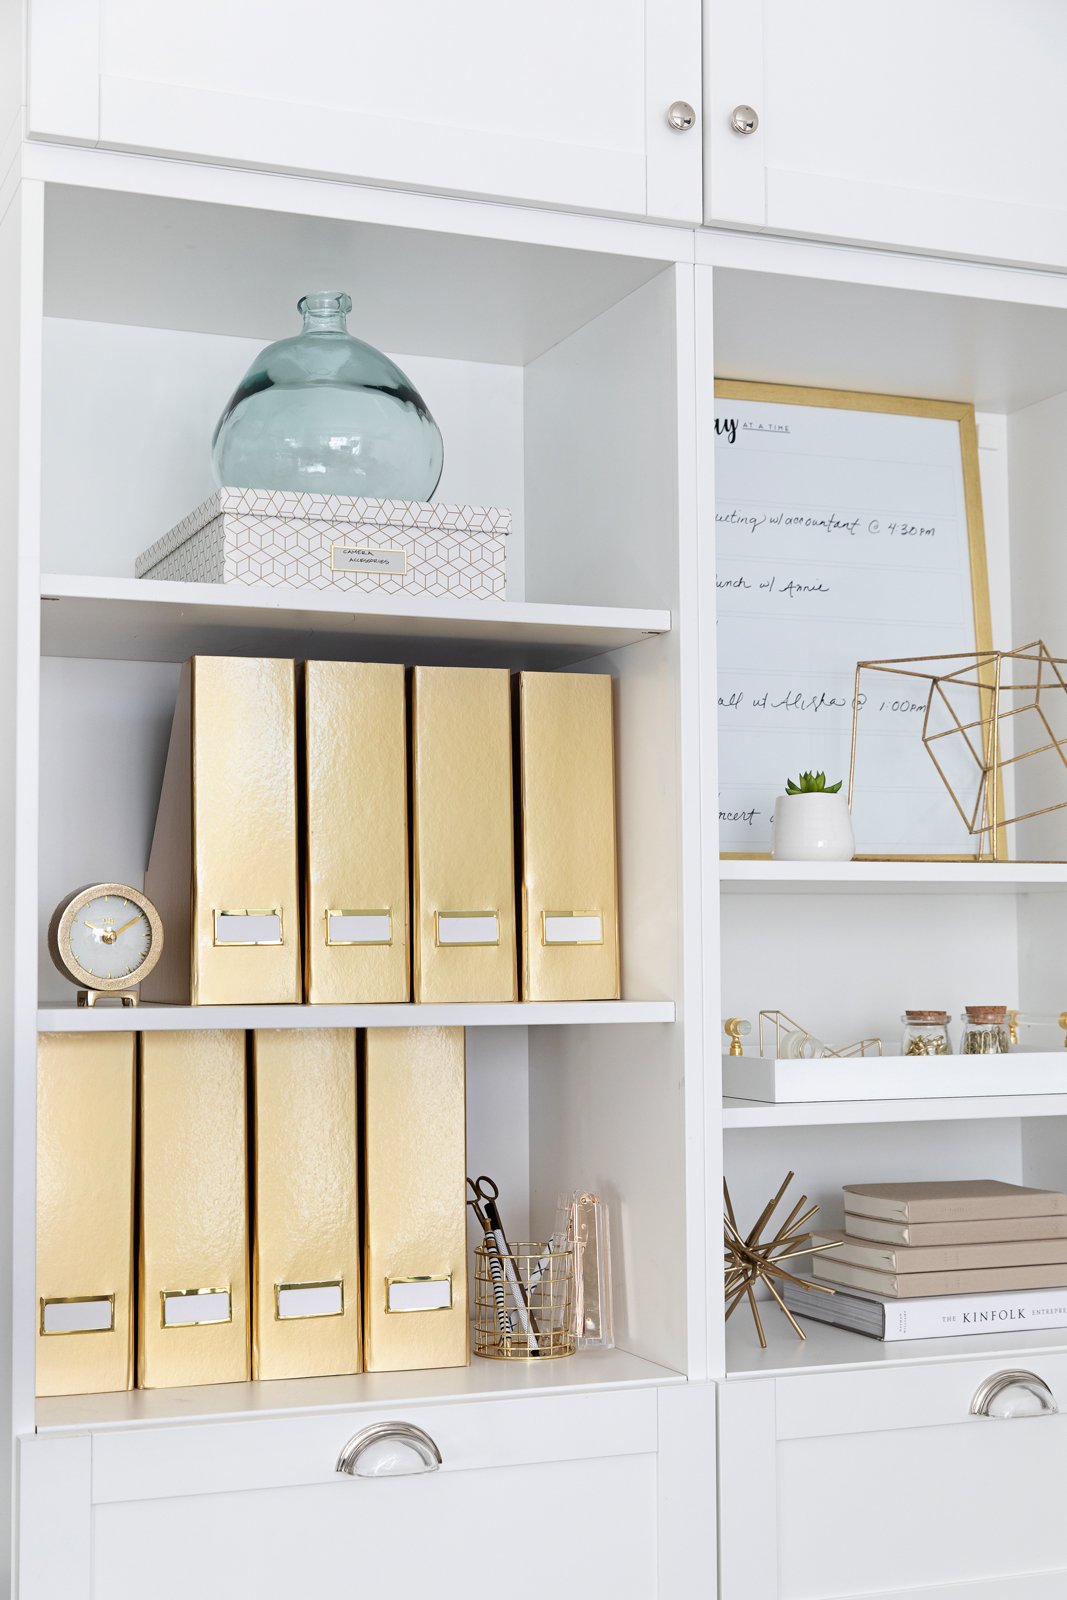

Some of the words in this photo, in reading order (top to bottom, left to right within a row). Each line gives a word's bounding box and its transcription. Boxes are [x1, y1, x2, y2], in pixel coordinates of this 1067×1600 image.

[768, 423, 789, 432] TIME
[868, 519, 881, 534] @
[759, 576, 775, 592] w/
[717, 691, 744, 709] all
[963, 1308, 1026, 1324] KINFOLK
